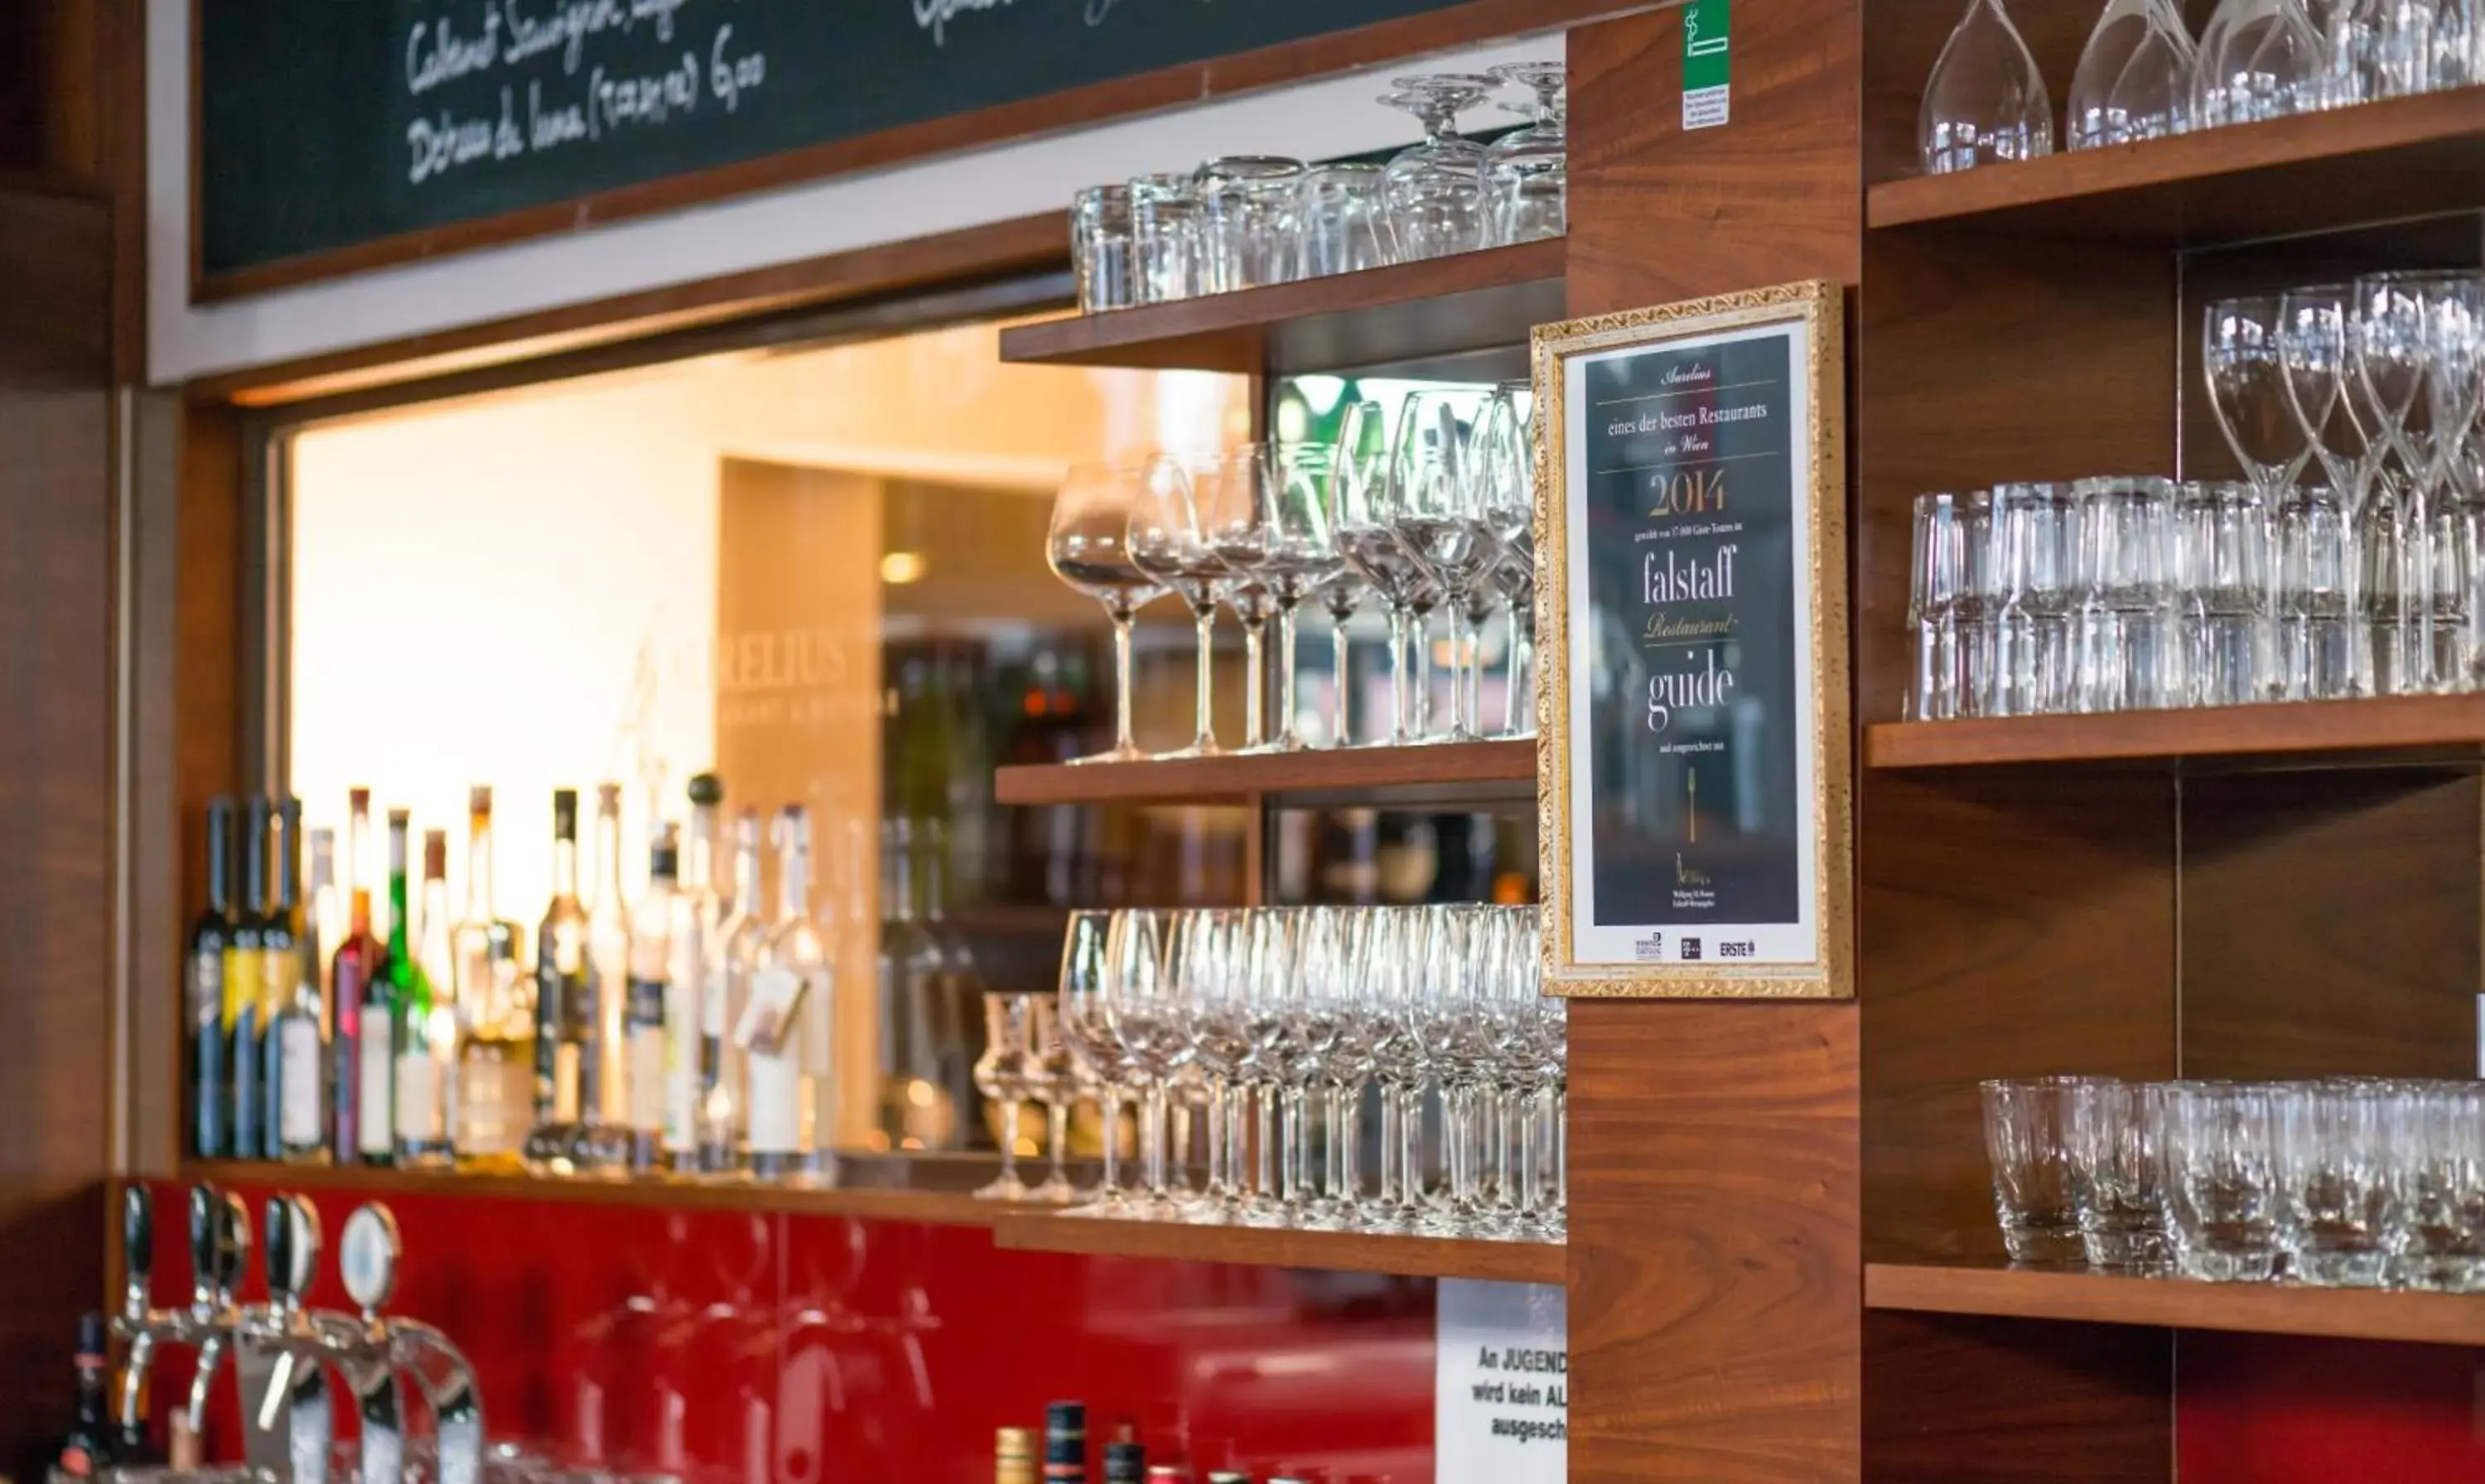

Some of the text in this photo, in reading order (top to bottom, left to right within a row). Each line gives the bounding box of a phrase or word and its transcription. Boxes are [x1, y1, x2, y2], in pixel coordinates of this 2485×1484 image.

[1608, 403, 1768, 436] eines der besten Restaurants
[1664, 433, 1710, 455] in Wien
[1648, 468, 1726, 518] 2014
[1643, 543, 1738, 605] falstaff
[1648, 648, 1735, 733] guide
[1720, 942, 1747, 956] ERSTE
[1479, 1346, 1567, 1374] An JUGEND
[1471, 1380, 1504, 1404] wird
[1508, 1382, 1542, 1407] kein
